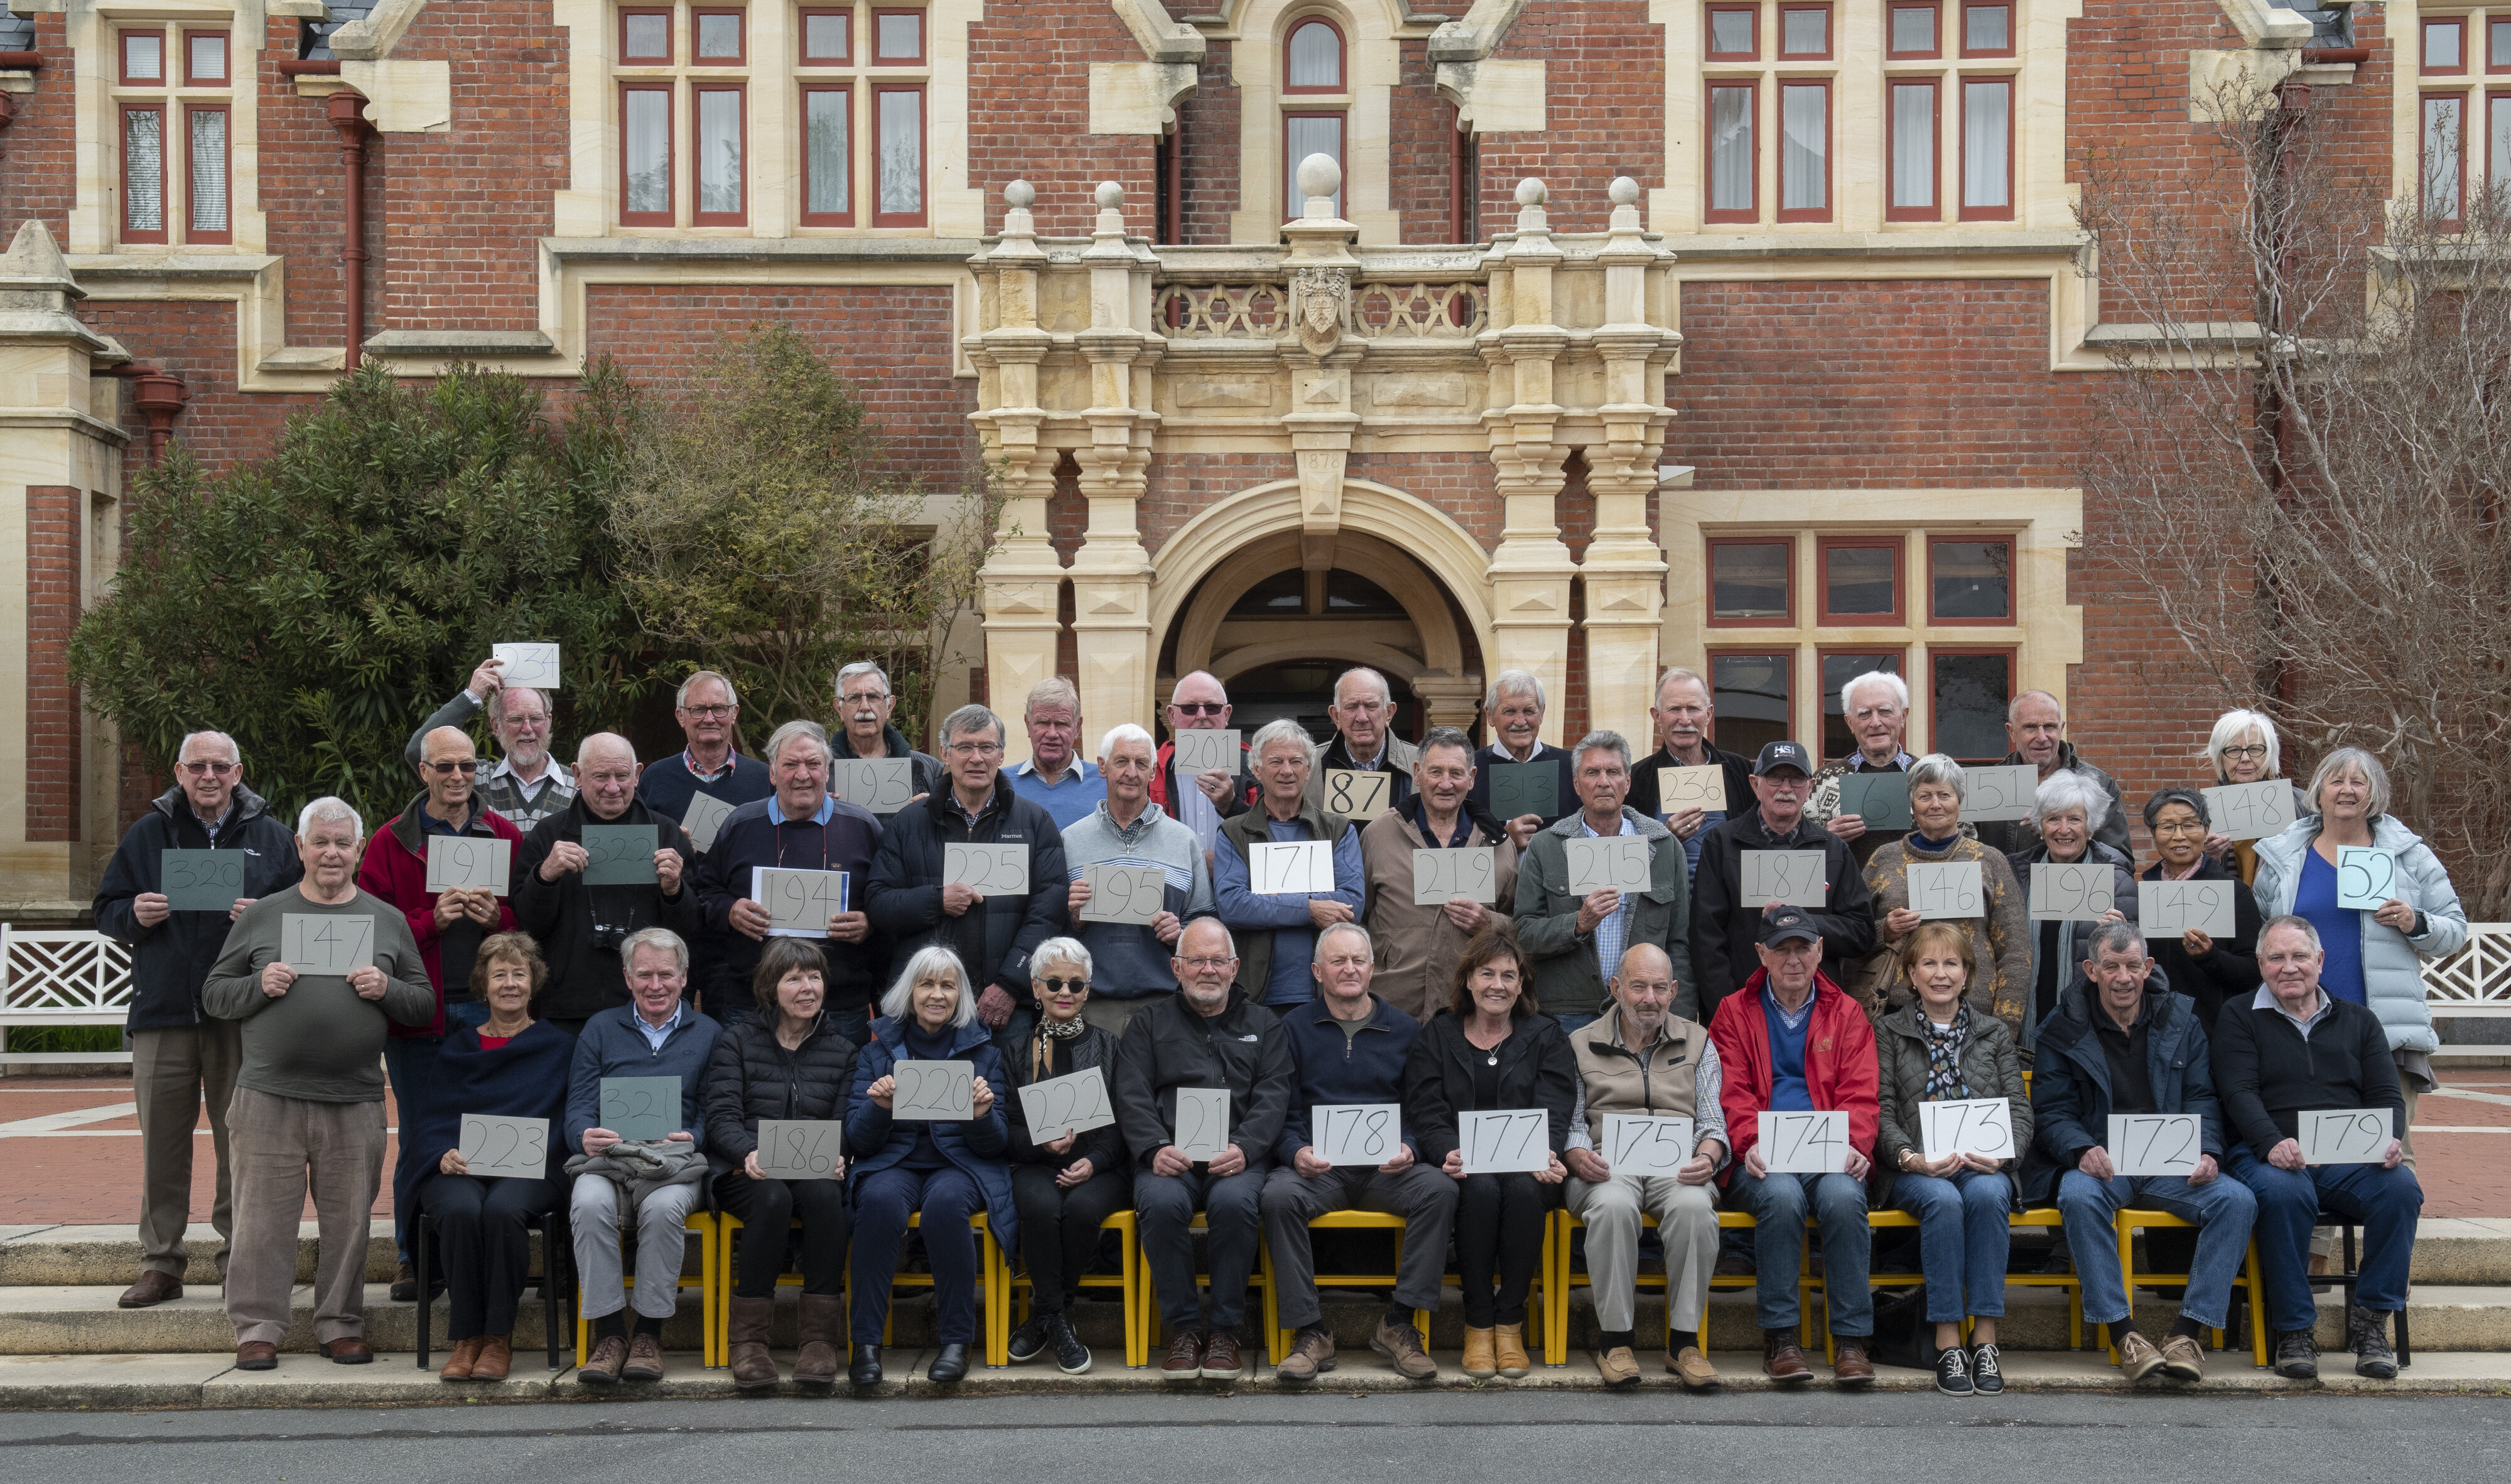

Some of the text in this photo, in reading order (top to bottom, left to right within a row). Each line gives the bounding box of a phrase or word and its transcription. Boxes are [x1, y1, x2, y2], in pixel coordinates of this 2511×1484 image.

[1304, 453, 1339, 468] 1878
[502, 647, 559, 680] 234
[1180, 734, 1232, 768] 201
[1774, 745, 1795, 754] HSI
[845, 763, 910, 805] 193
[1331, 772, 1385, 814] 87
[1494, 775, 1553, 803] 313
[1663, 771, 1720, 802] 236
[1862, 778, 1891, 821] 6
[1960, 770, 2033, 812] 151
[2214, 785, 2281, 832] 148
[429, 840, 502, 886] 191
[586, 837, 654, 865] 322
[949, 848, 1025, 889] 225
[1265, 846, 1314, 892] 171
[1575, 843, 1645, 886] 215
[170, 860, 241, 888] 320
[1081, 866, 1162, 916] 195
[1419, 852, 1491, 896] 219
[1748, 854, 1821, 898] 187
[1913, 866, 1975, 911] 146
[2032, 865, 2112, 913] 196
[2341, 851, 2393, 901] 52
[762, 874, 838, 925] 194
[2149, 886, 2219, 928] 149
[291, 920, 371, 967] 147
[603, 1087, 669, 1123] 321
[900, 1068, 971, 1111] 220
[1027, 1075, 1111, 1132] 222
[466, 1121, 545, 1168] 223
[1183, 1095, 1226, 1153] 21
[1324, 1109, 1389, 1154] 178
[1471, 1114, 1542, 1166] 177
[1614, 1120, 1681, 1167] 175
[1771, 1116, 1842, 1173] 174
[1932, 1104, 2007, 1153] 173
[2121, 1118, 2195, 1171] 172
[2312, 1114, 2382, 1156] 179
[761, 1126, 829, 1173] 186
